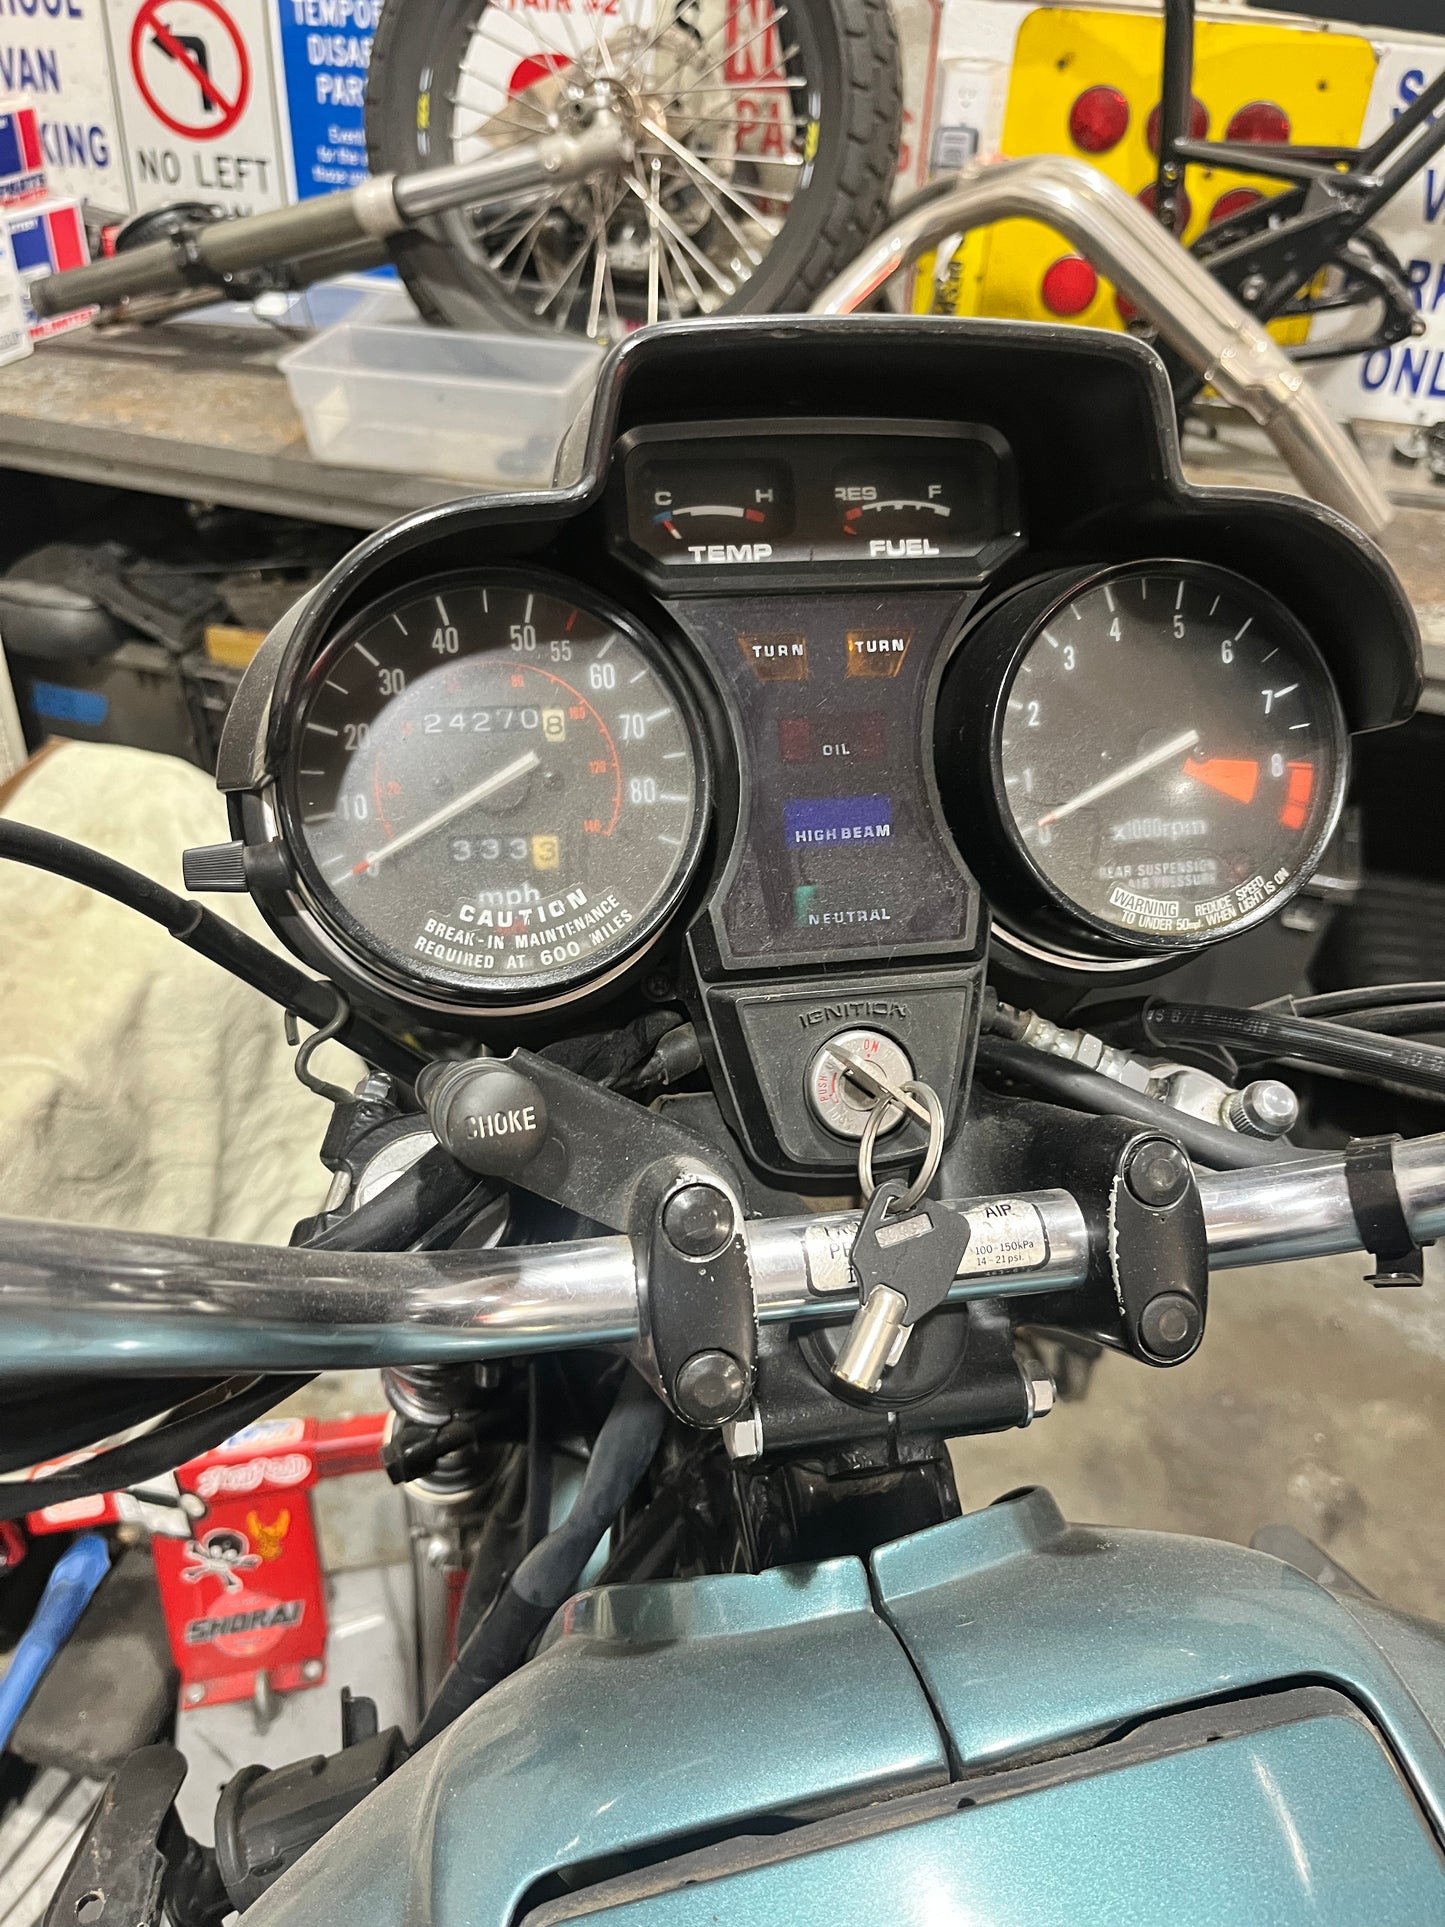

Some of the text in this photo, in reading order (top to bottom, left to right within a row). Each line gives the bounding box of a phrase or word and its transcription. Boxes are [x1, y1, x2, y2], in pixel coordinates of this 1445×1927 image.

[0, 47, 61, 92] VAN
[315, 72, 369, 107] PAR
[137, 149, 270, 194] NO LEFT
[654, 491, 673, 506] C
[755, 488, 774, 503] H
[928, 484, 942, 499] F
[688, 543, 773, 563] TEMP
[869, 538, 940, 557] FUEL
[510, 625, 537, 651] 50
[1109, 617, 1122, 642] 4
[1173, 614, 1185, 639] 5
[431, 626, 460, 654] 40
[550, 640, 572, 662] 55
[752, 644, 804, 659] TURN
[855, 638, 905, 653] TURN
[1220, 639, 1234, 664] 6
[1063, 645, 1076, 671] 3
[378, 668, 406, 696] 30
[589, 662, 616, 690] 60
[1028, 701, 1040, 727] 2
[1261, 688, 1274, 714] 7
[343, 722, 370, 751] 20
[617, 711, 645, 740] 70
[822, 743, 851, 756] OIL
[1271, 753, 1284, 778] 8
[630, 777, 657, 804] 80
[1023, 768, 1033, 793] 1
[341, 793, 368, 820] 10
[795, 824, 891, 843] HIGH BEAM
[478, 881, 541, 906] mph
[1113, 875, 1266, 917] WARNING REDUCE SPEED
[1120, 909, 1135, 925] TO
[1138, 916, 1172, 931] UNDER
[1205, 908, 1237, 927] WHEN
[1238, 892, 1264, 914] LIGHT
[1263, 882, 1275, 896] IS
[1274, 867, 1291, 885] ON
[459, 888, 588, 928] CAUTION
[808, 908, 891, 925] NEUTRAL
[424, 918, 505, 950] BREAK-IN
[515, 894, 620, 949] MAINTENANCE
[414, 908, 633, 970] REQUIRED AT 600 MILES
[798, 1001, 909, 1028] IGNITION
[863, 1039, 880, 1053] ON
[817, 1075, 829, 1103] PUSH
[463, 1105, 537, 1140] CHOKE
[188, 1600, 303, 1644] SHORAI
